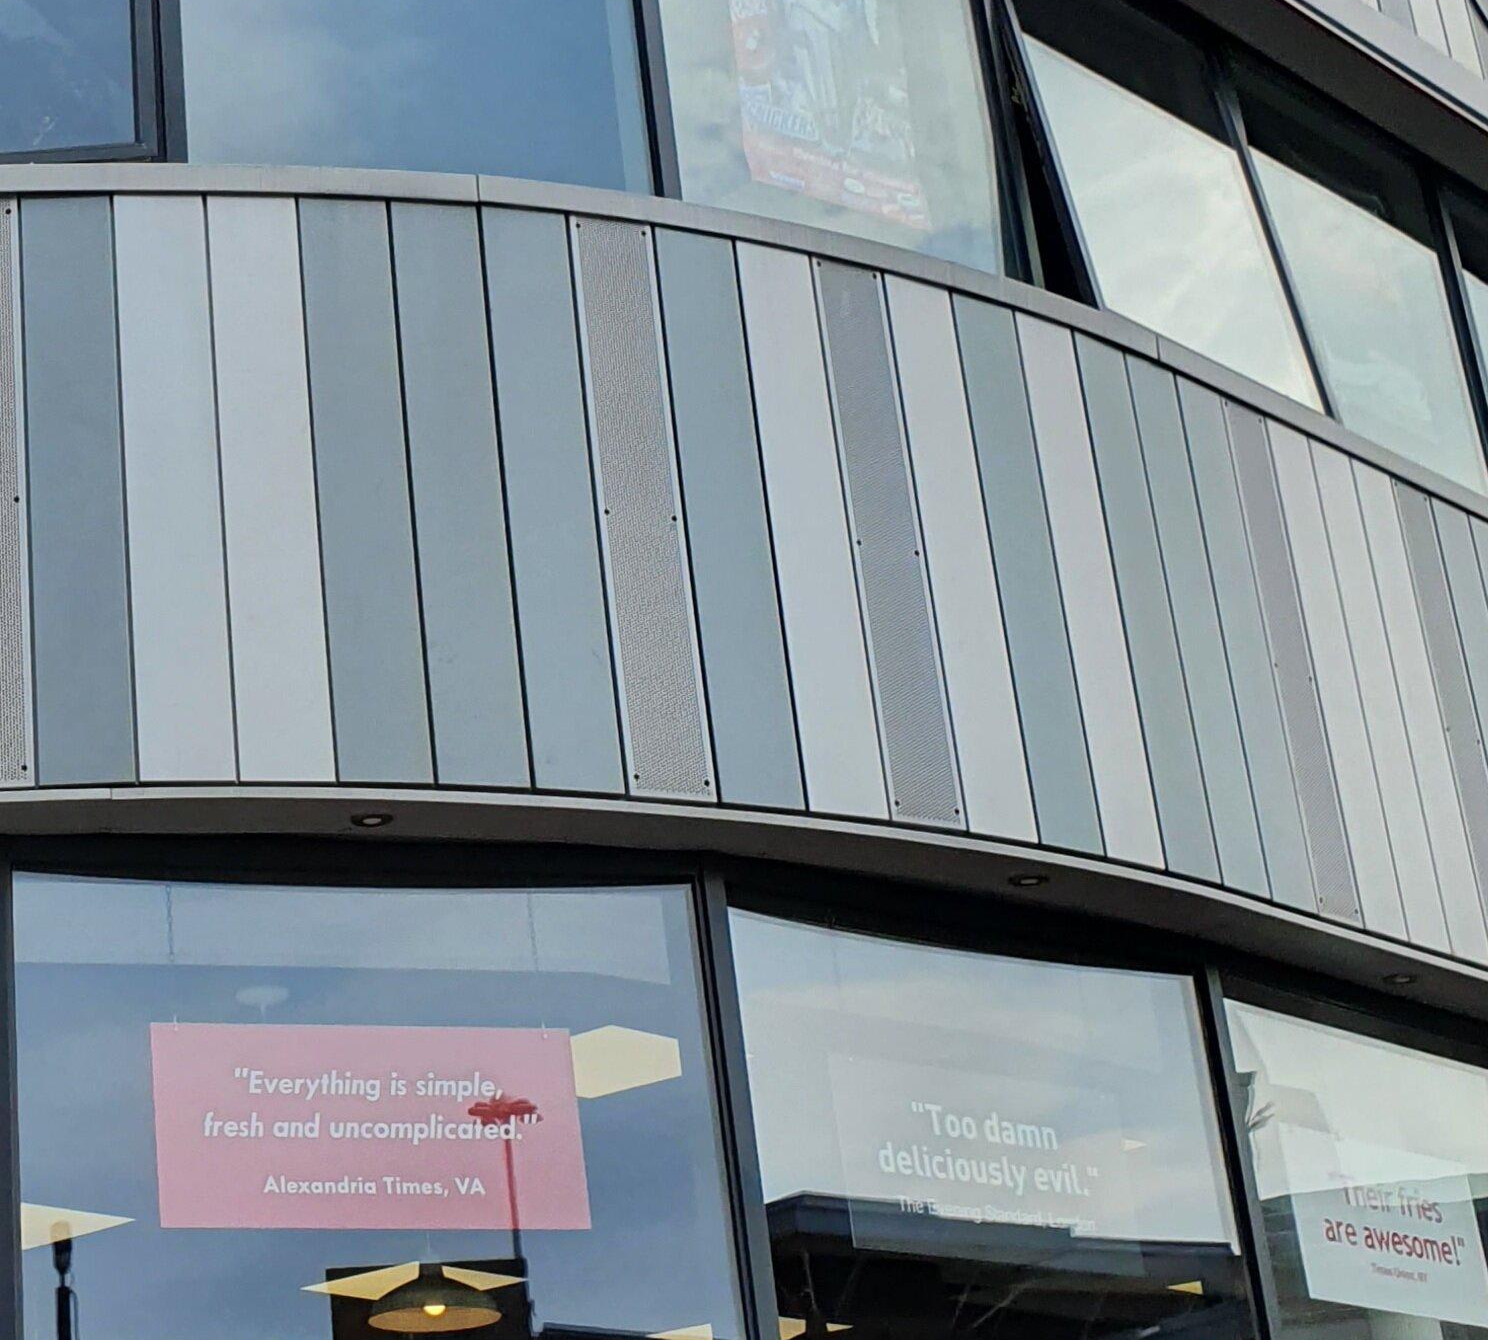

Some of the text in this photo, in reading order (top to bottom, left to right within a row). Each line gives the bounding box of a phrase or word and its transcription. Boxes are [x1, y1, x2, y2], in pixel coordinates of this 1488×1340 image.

[234, 1067, 503, 1102] "Everything is simple,
[203, 1112, 539, 1145] fresh and uncomplicated."
[911, 1100, 1059, 1151] "Too damn
[263, 1175, 486, 1198] Alexandria Times, VA
[878, 1141, 1099, 1197] deliciously evil."
[899, 1195, 924, 1214] The
[1323, 1218, 1465, 1266] are awesome!"
